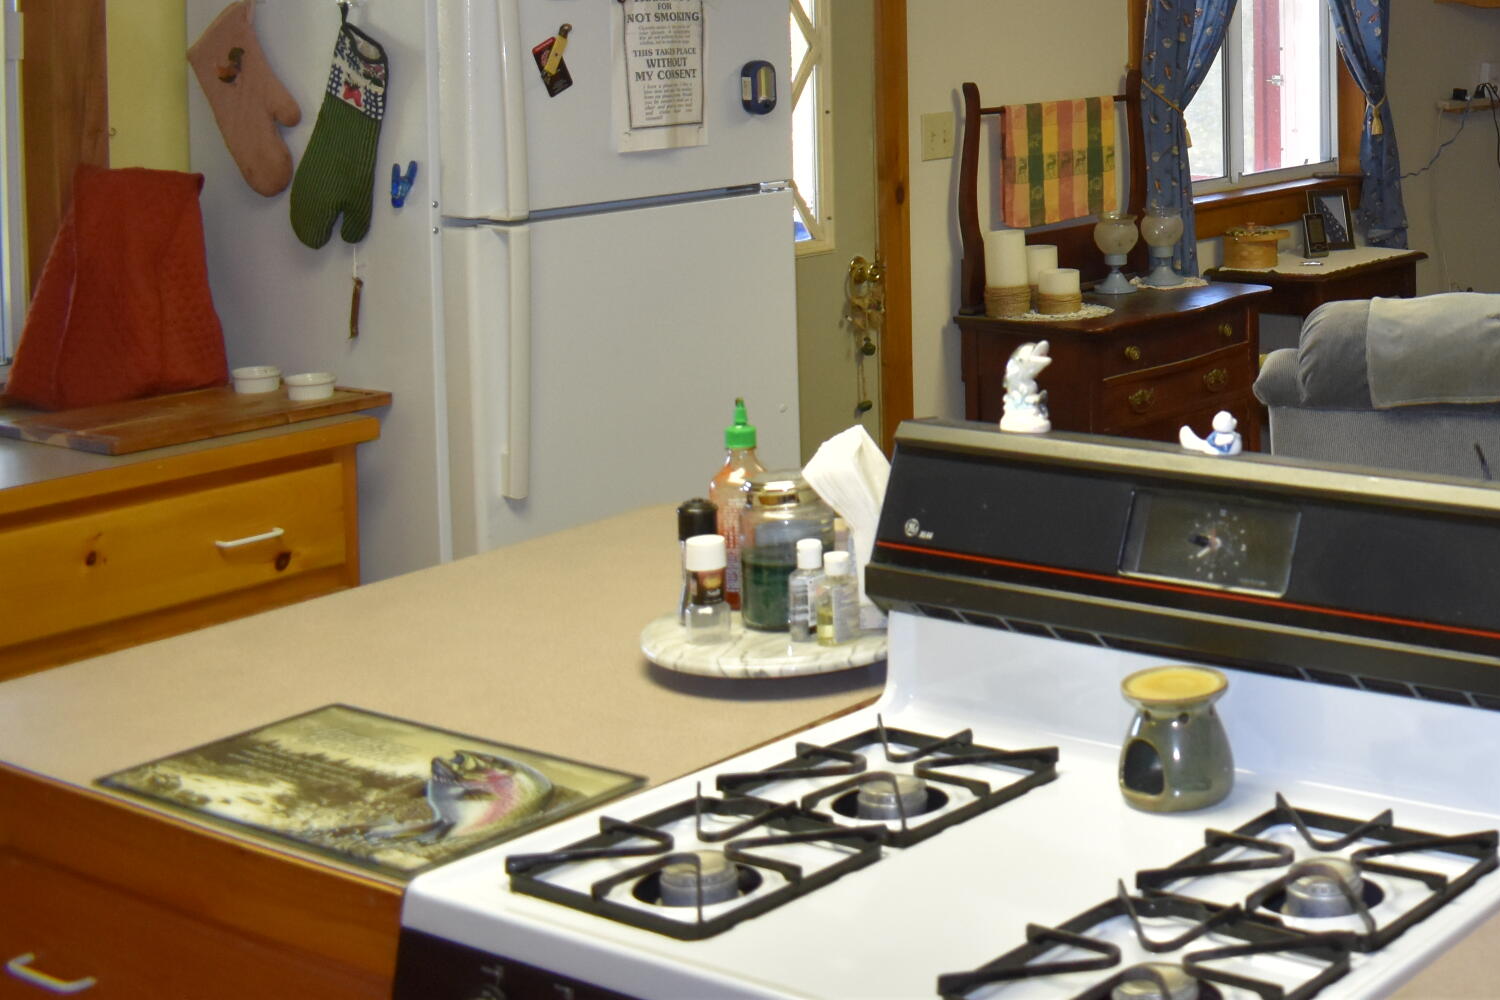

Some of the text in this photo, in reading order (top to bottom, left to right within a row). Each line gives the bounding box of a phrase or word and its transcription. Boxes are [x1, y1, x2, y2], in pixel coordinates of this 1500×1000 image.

[627, 11, 700, 23] NOT SMOKING
[633, 48, 653, 57] THIS
[676, 47, 696, 55] PLACE
[646, 57, 687, 68] WITHOUT
[635, 68, 697, 81] MY CONSENT
